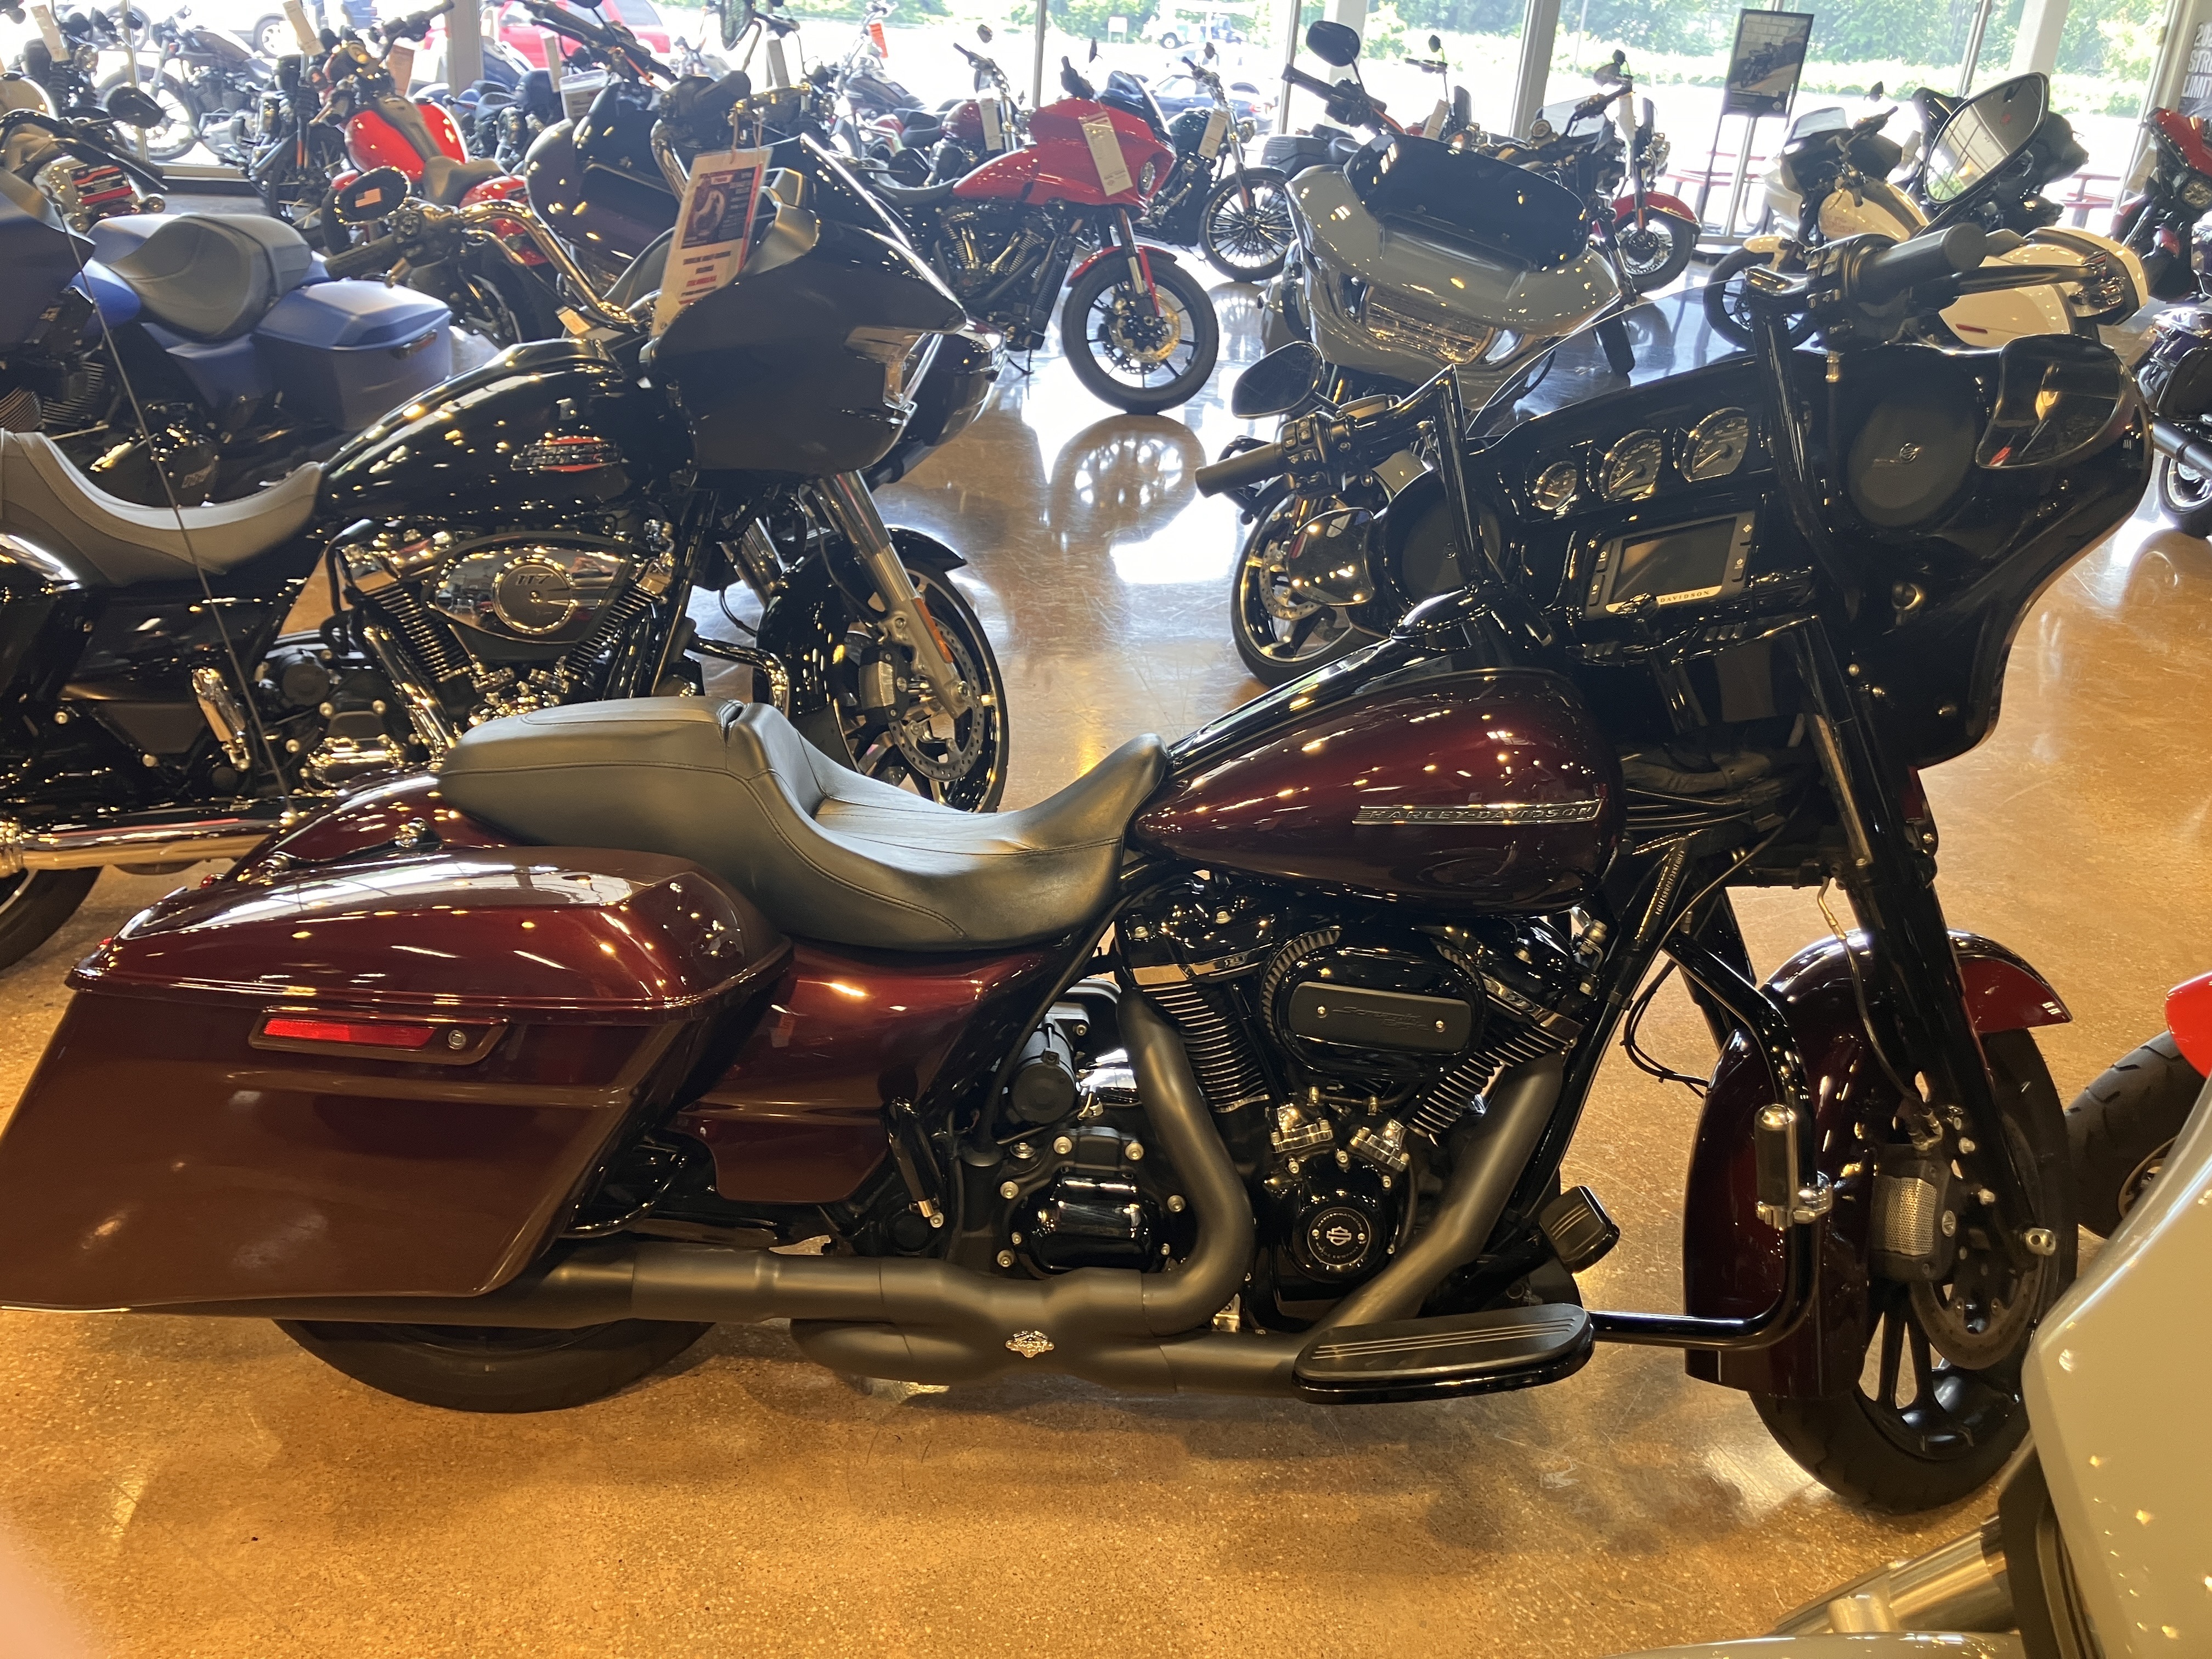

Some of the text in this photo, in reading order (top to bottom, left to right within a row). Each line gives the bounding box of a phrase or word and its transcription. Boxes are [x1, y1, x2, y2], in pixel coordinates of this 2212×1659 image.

[516, 573, 554, 586] 117
[1660, 590, 1710, 603] DAVIDSON
[1369, 806, 1592, 819] HARLEY-DAVIDSON
